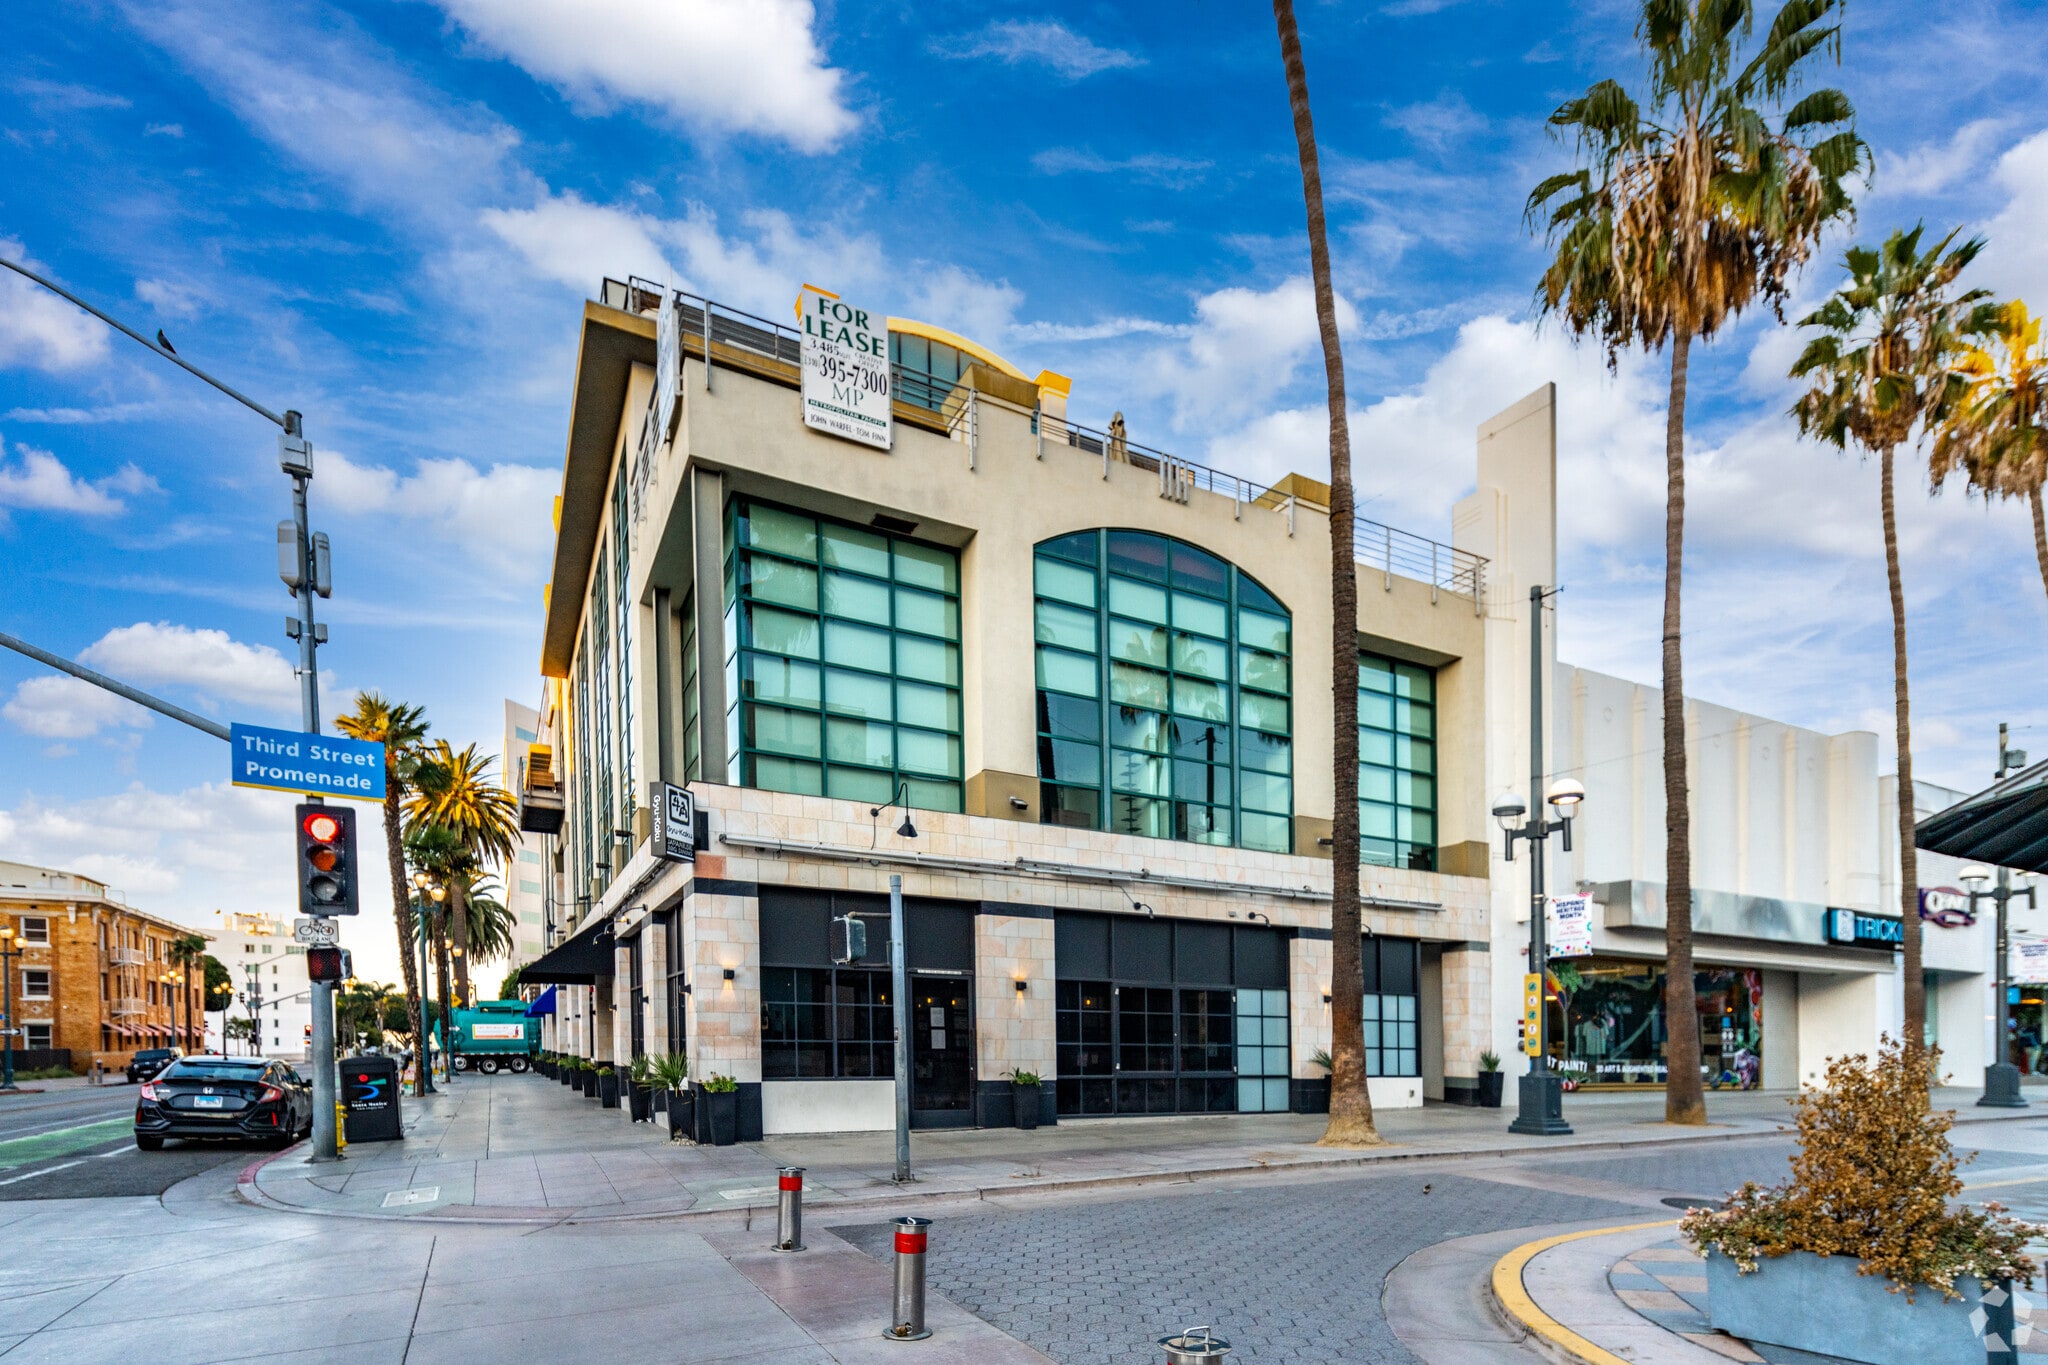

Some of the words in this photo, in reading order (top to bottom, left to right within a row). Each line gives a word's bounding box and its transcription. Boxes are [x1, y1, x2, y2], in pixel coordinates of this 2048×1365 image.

[818, 297, 869, 330] FOR
[805, 314, 885, 358] LEASE
[820, 354, 887, 396] 395-7300
[832, 382, 864, 407] MP
[810, 399, 860, 418] METROPOLITAN
[810, 414, 827, 425] JOHN
[856, 427, 870, 438] TOM
[872, 432, 886, 442] FINN
[241, 735, 299, 757] Third
[309, 745, 375, 767] Street
[246, 761, 372, 790] Promenade
[653, 794, 661, 843] Gyu-Kaku
[666, 825, 693, 840] Gyu-Kaku
[1556, 900, 1585, 908] HISPANIC
[1556, 905, 1585, 914] HERITAGE
[1856, 915, 1903, 942] TRICK
[1558, 1060, 1588, 1073] PAINT!
[1604, 1064, 1616, 1073] ART
